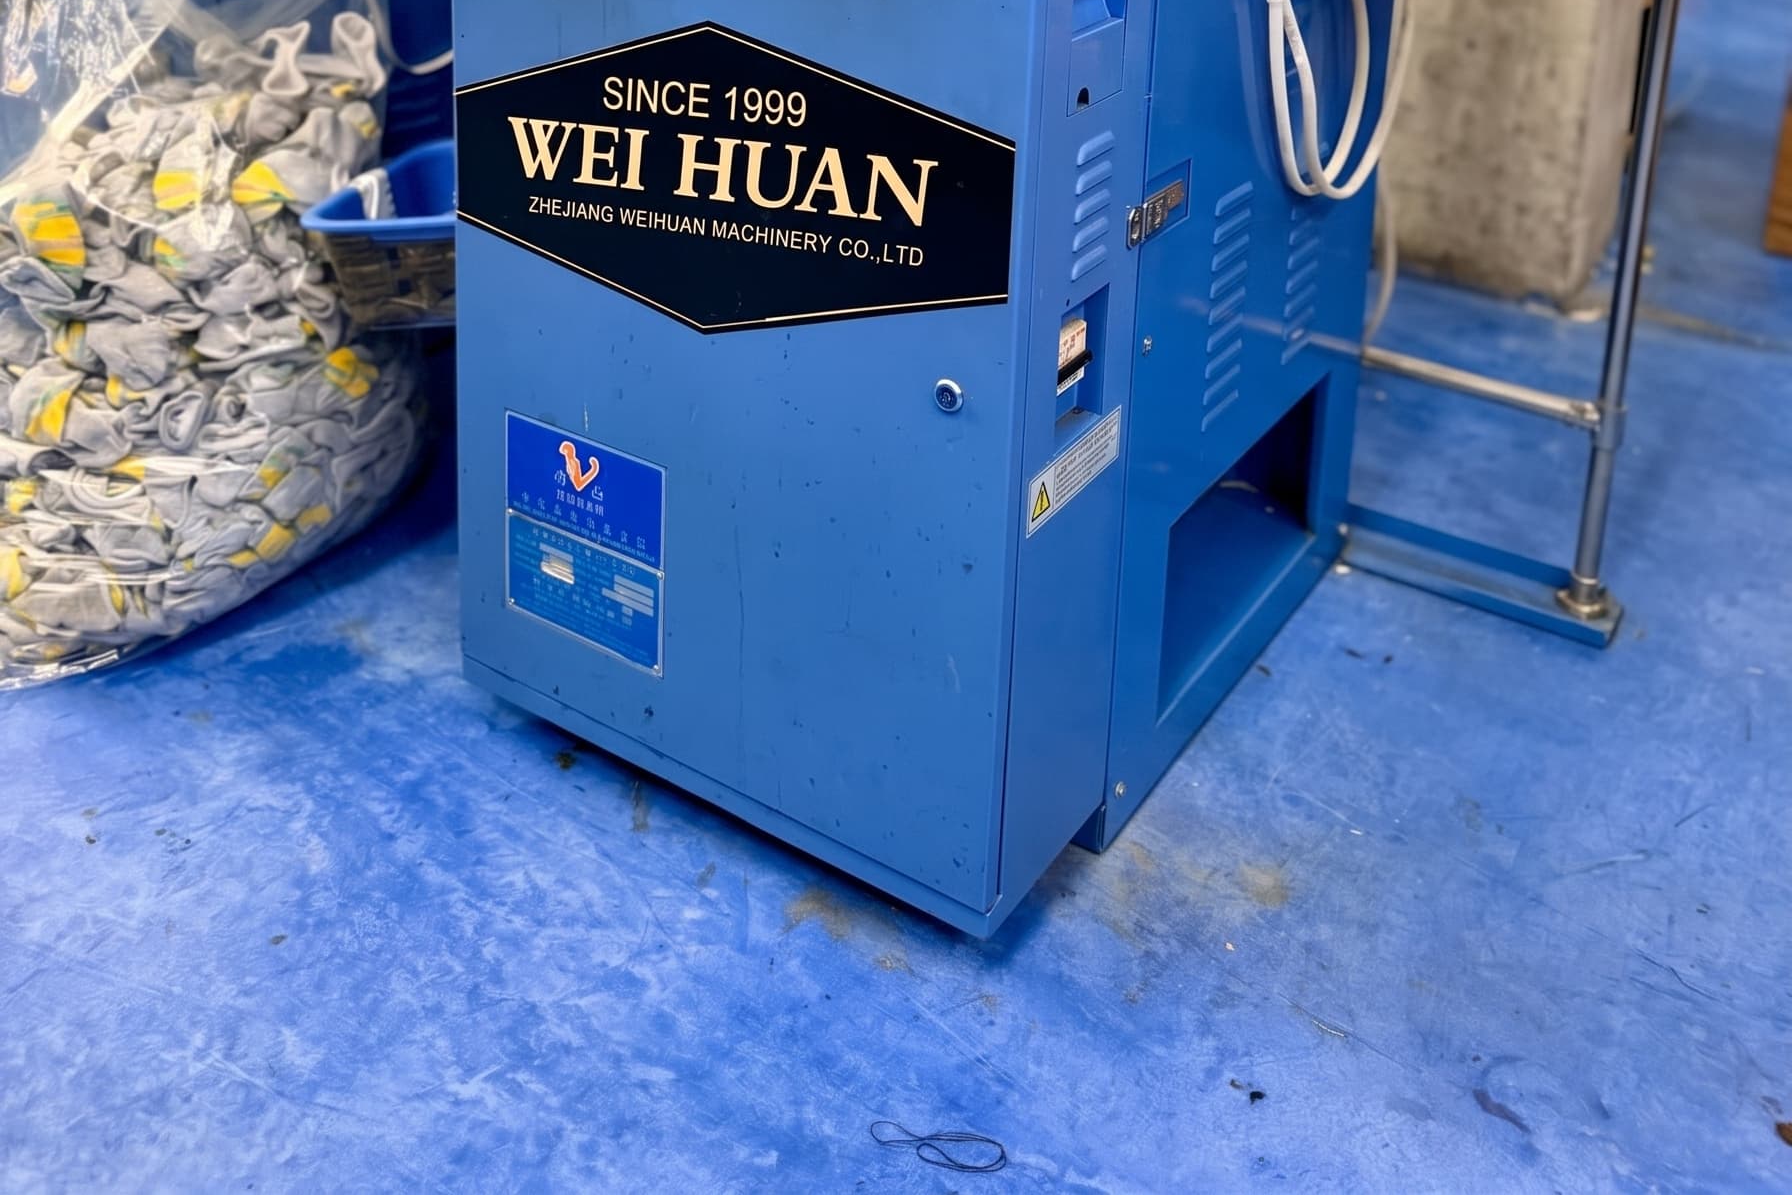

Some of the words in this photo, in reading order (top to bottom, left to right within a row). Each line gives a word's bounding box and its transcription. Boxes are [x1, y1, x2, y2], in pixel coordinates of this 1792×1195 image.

[602, 76, 711, 118] SINCE
[724, 86, 807, 127] 1999
[507, 116, 650, 191] WEI
[673, 133, 939, 227] HUAN
[528, 196, 614, 223] ZHEJIANG
[619, 207, 706, 236] WEIHUAN
[712, 219, 833, 254] MACHINERY
[838, 237, 924, 267] CO.,LTD
